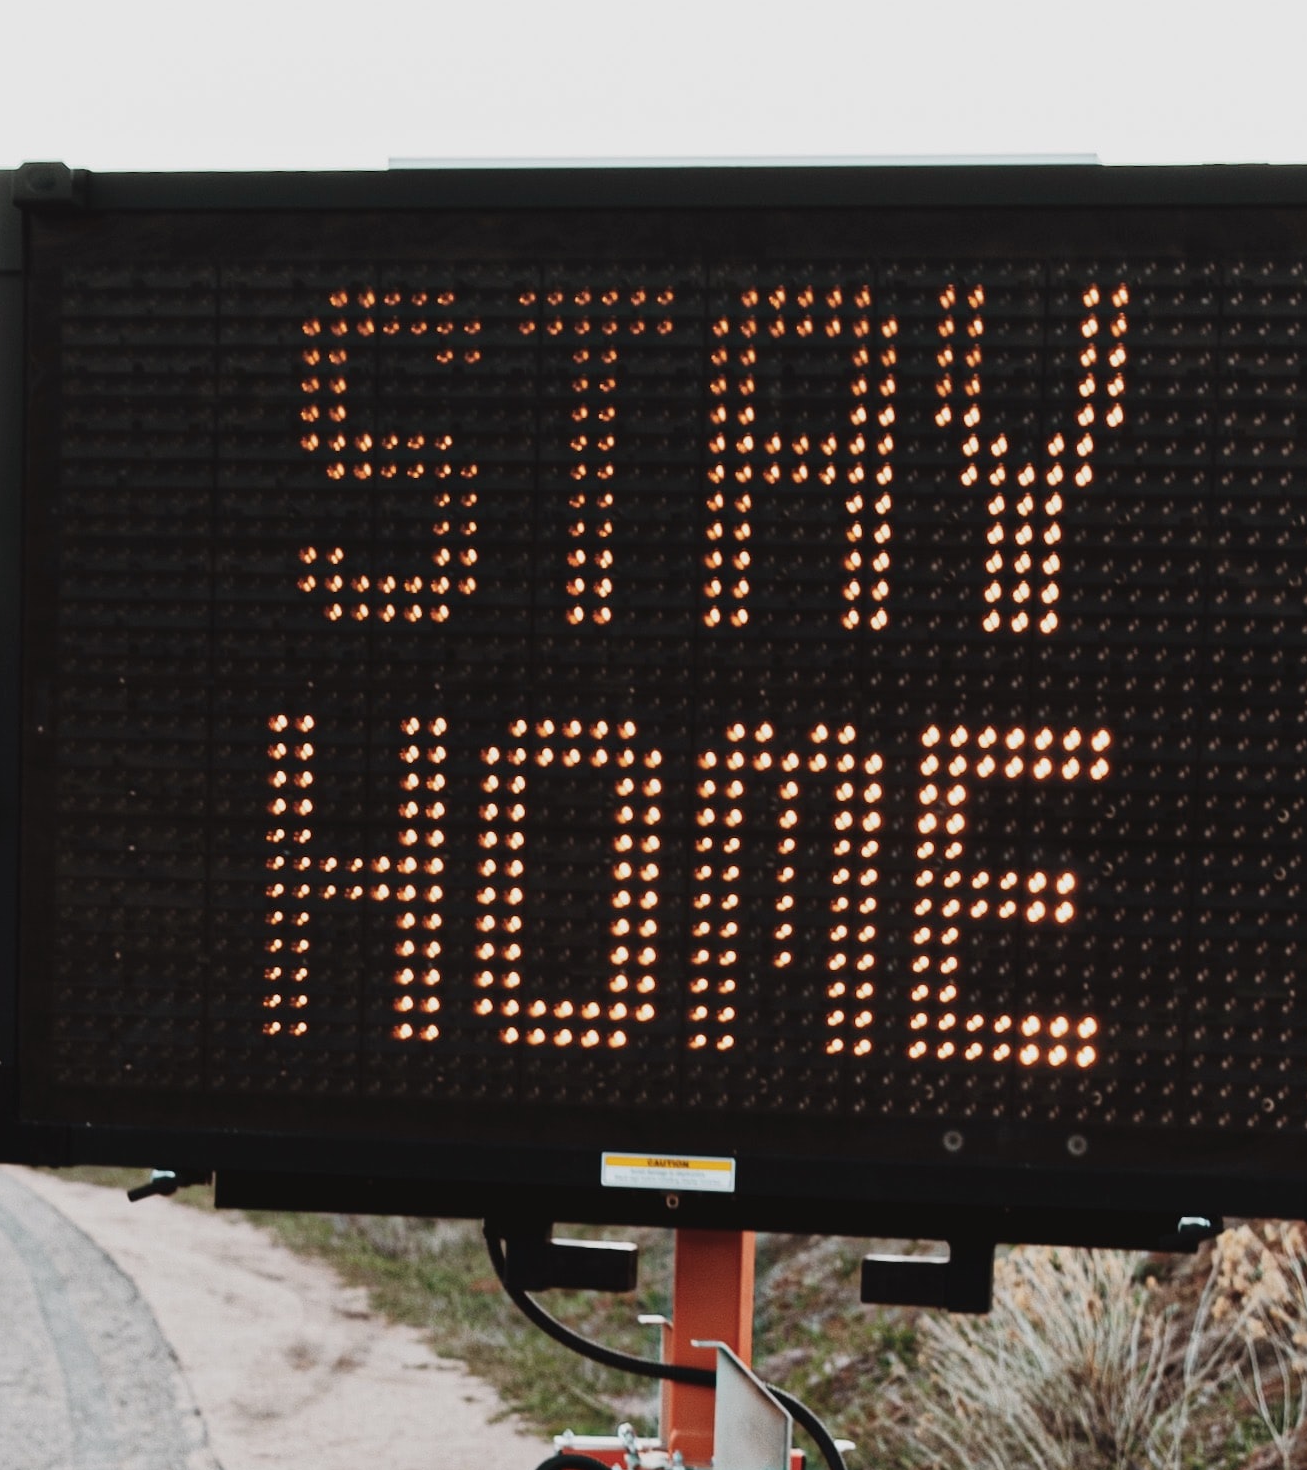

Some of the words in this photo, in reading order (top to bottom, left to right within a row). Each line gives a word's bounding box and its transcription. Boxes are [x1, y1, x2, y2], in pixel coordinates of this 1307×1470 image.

[297, 283, 1131, 634] STAY
[263, 713, 1111, 1068] HOME
[646, 1158, 690, 1169] CAUTION
